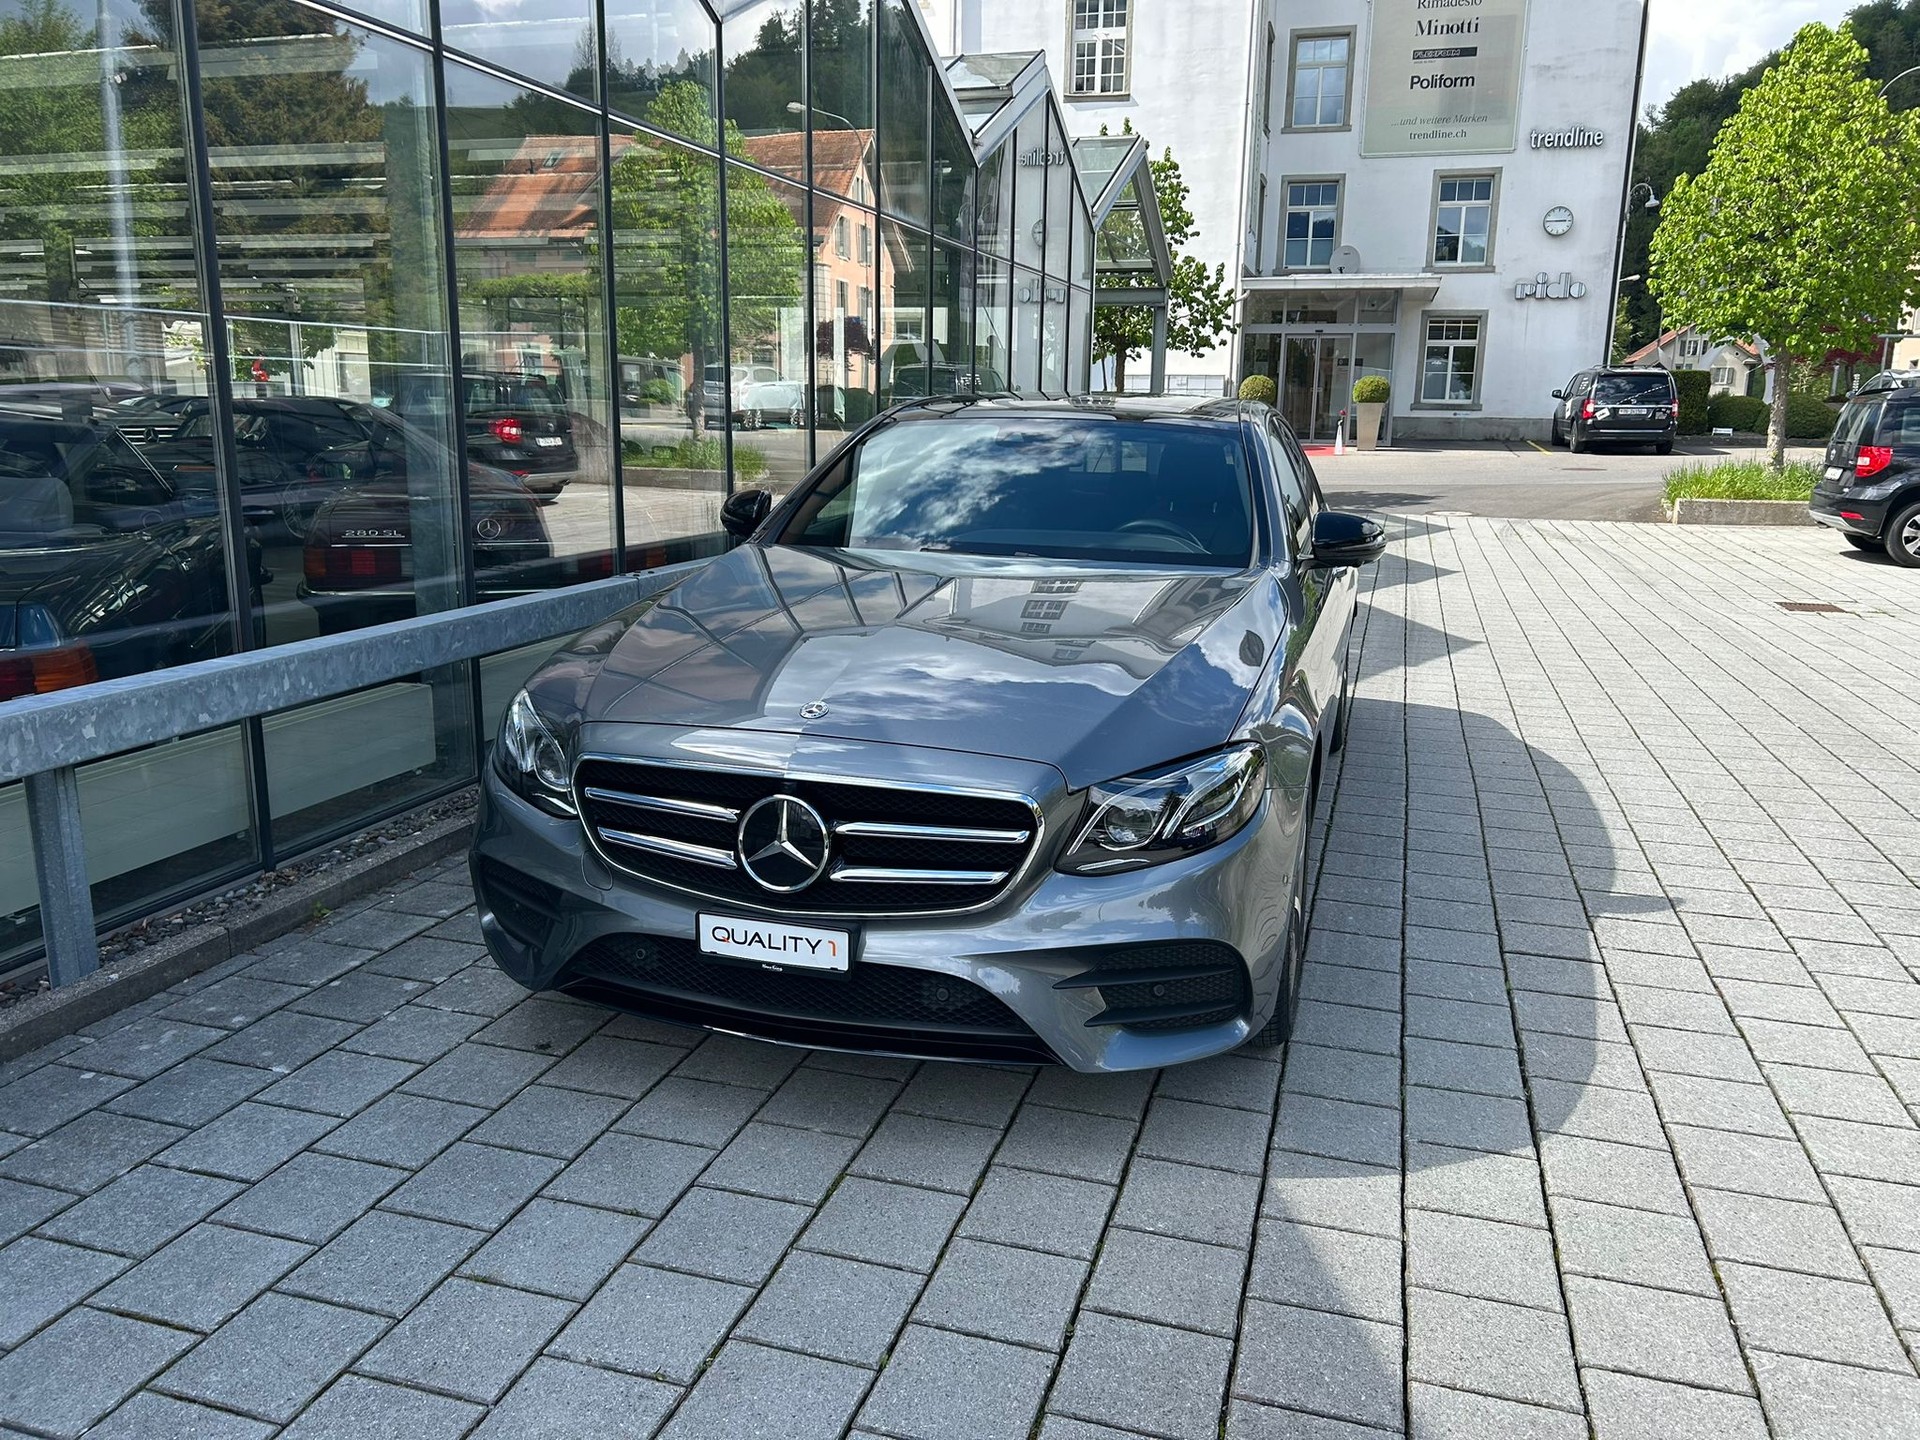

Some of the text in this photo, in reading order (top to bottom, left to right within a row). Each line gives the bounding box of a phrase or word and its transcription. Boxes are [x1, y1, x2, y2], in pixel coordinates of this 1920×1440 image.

[1415, 16, 1480, 36] Minotti
[1410, 74, 1475, 90] Poliform
[1419, 115, 1452, 125] weitere
[1453, 113, 1488, 124] Marken
[1409, 129, 1467, 140] trendline.ch
[1530, 126, 1604, 149] trendline
[1515, 271, 1587, 300] rido
[345, 529, 402, 537] 280 SL
[711, 926, 822, 954] QUALITY
